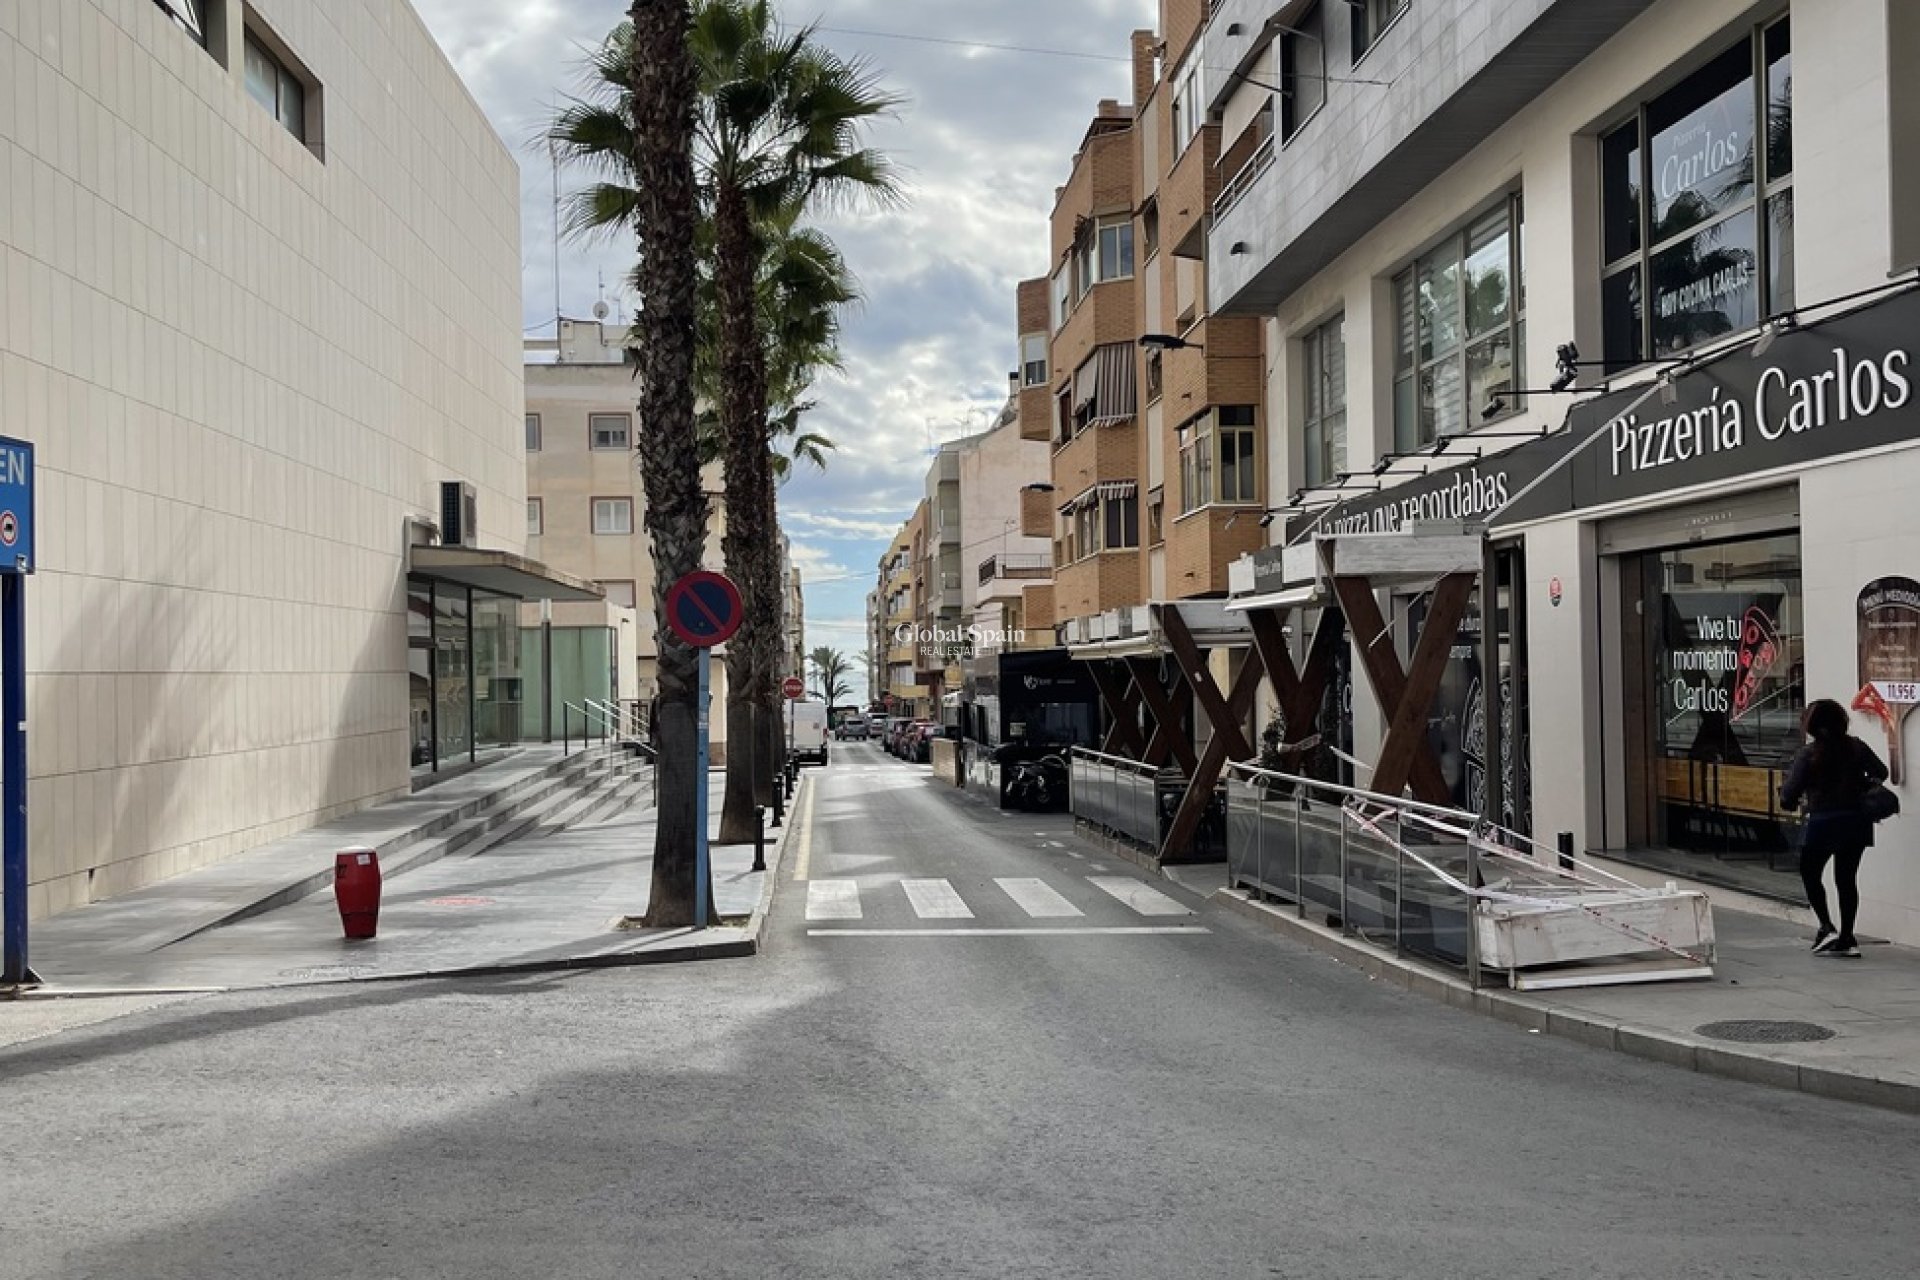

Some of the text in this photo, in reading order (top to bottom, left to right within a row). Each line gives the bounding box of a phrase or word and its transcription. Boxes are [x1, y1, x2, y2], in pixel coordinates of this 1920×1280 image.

[1661, 130, 1739, 199] Carlos
[1610, 347, 1911, 477] Pizzería Carlos
[1399, 467, 1508, 521] recordabas
[1696, 615, 1742, 640] Vive tu
[1673, 647, 1738, 671] momento
[1673, 679, 1728, 713] Carlos
